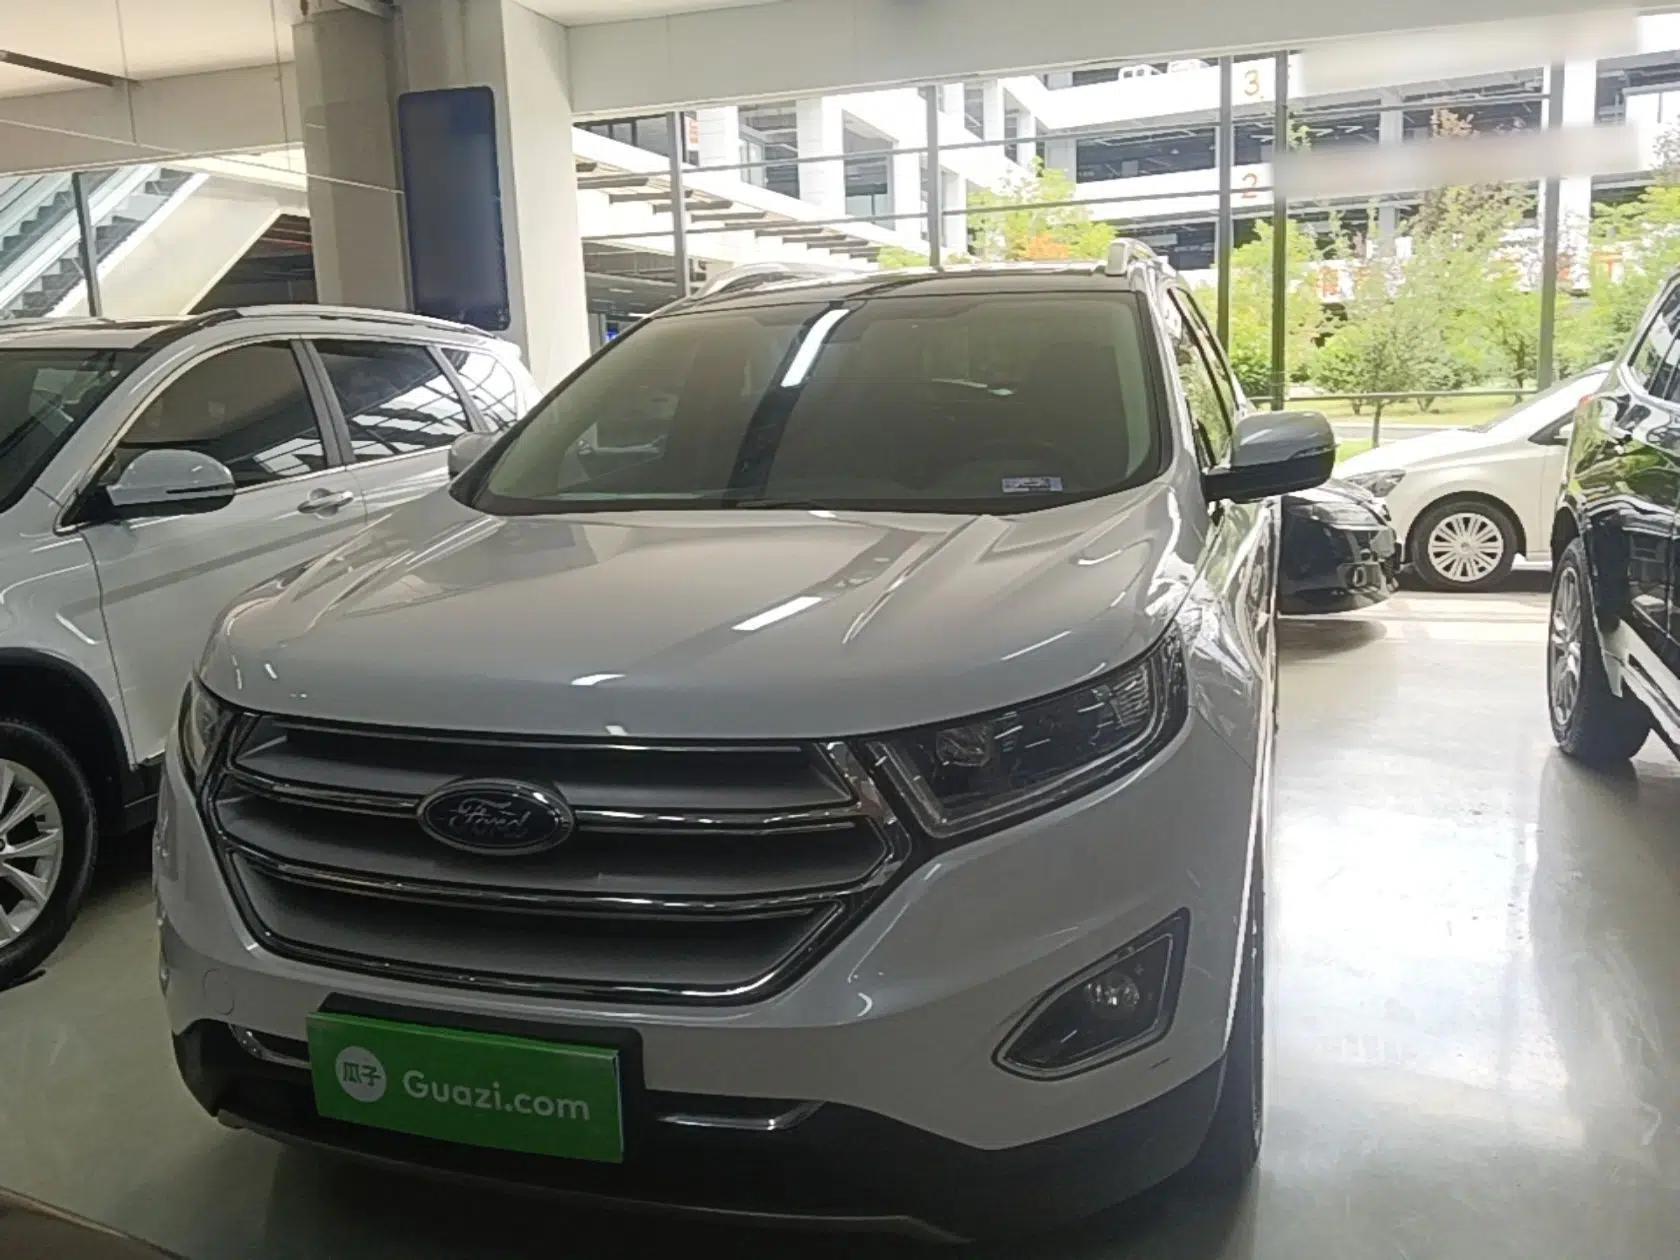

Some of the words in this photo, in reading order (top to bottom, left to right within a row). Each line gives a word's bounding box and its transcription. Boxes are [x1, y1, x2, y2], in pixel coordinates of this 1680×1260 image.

[1244, 70, 1260, 96] 3
[1242, 173, 1257, 198] 2
[449, 798, 532, 838] Ford
[343, 1062, 381, 1087] 瓜子
[402, 1070, 590, 1120] Guazi.com
